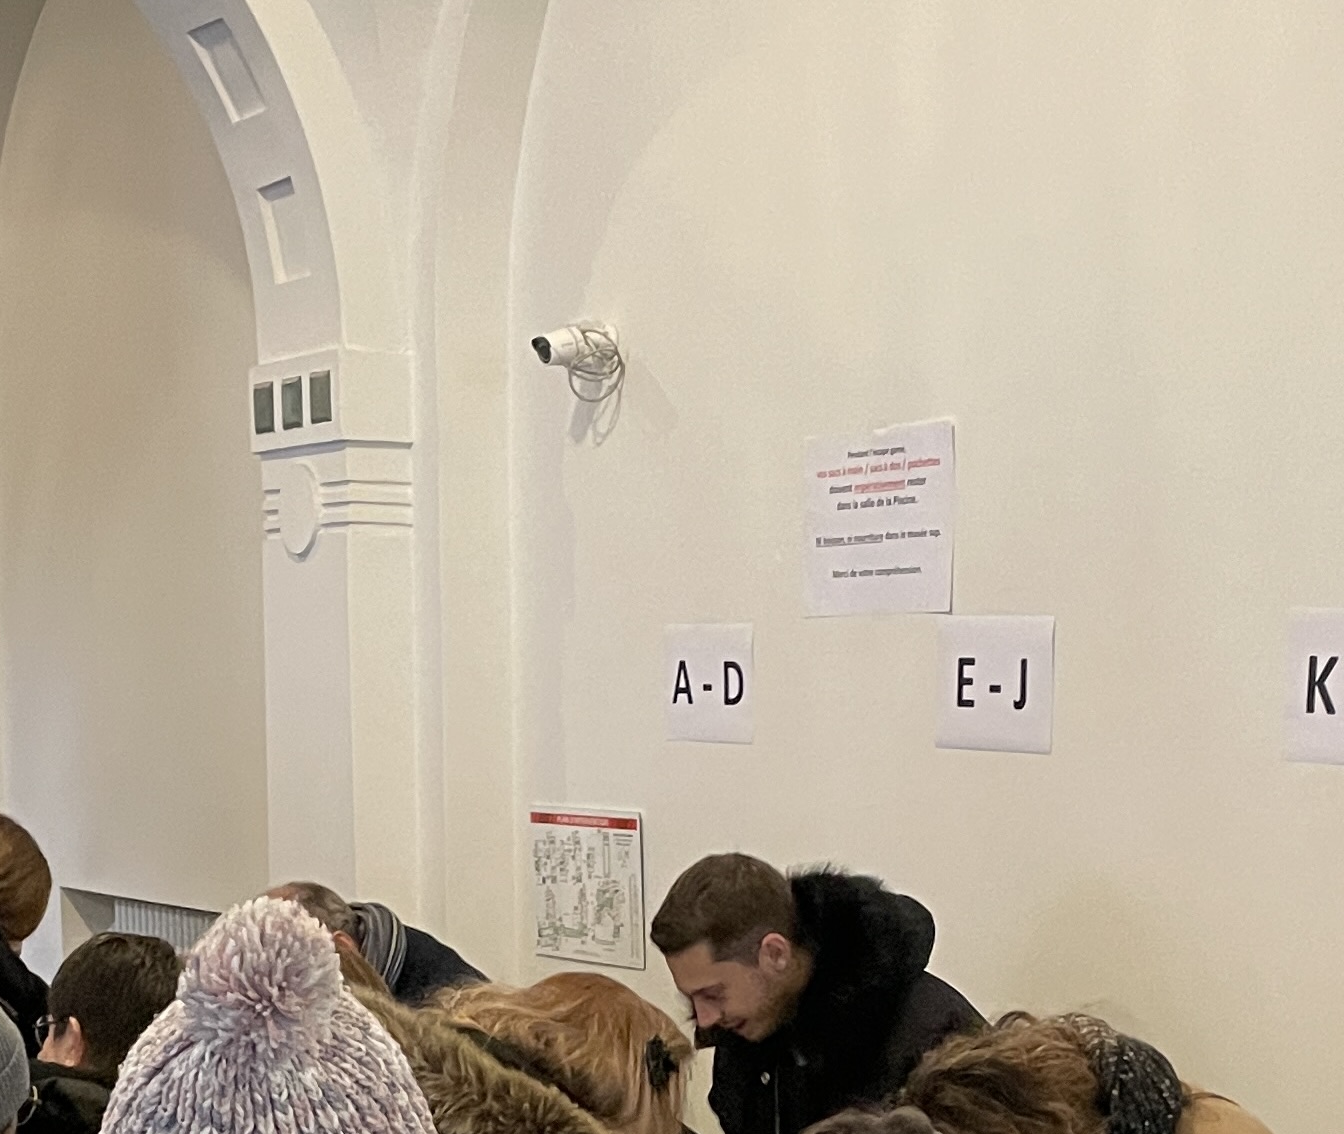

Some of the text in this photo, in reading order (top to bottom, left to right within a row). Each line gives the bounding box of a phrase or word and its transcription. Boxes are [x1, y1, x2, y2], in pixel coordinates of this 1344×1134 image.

[672, 660, 694, 705] A
[723, 660, 744, 706] D
[956, 657, 976, 708] E
[1013, 658, 1028, 710] J
[1305, 655, 1339, 715] K
